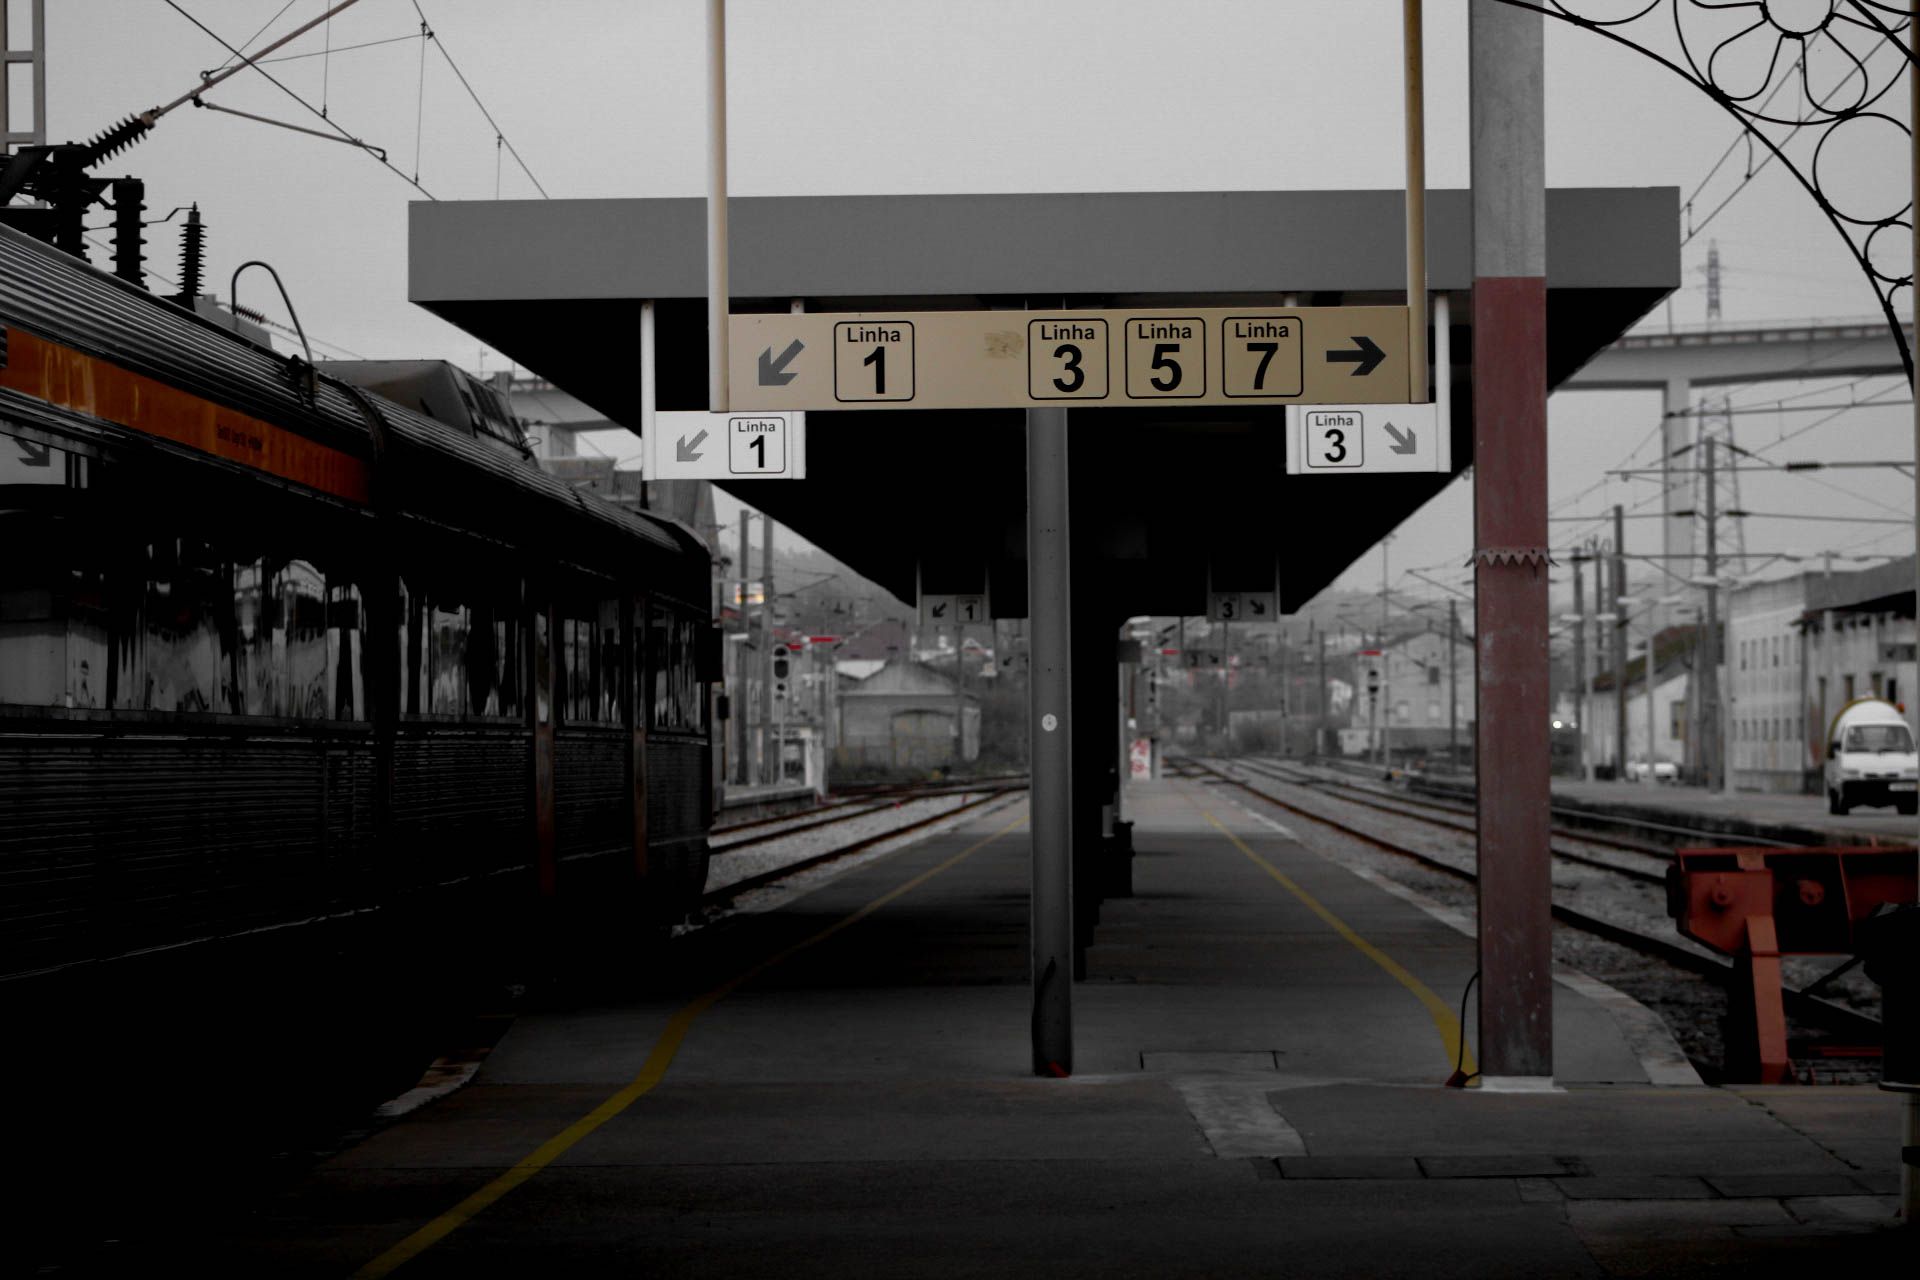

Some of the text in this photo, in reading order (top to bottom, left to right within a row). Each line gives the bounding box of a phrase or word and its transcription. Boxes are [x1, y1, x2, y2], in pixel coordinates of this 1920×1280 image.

[847, 326, 901, 343] Linha
[1041, 324, 1095, 340] Linha
[1138, 323, 1192, 339] Linha
[1235, 321, 1289, 338] Linha
[863, 345, 886, 395] 1
[1052, 343, 1085, 393] 3
[1150, 343, 1183, 392] 5
[1246, 342, 1279, 390] 7
[738, 421, 776, 432] Linha
[1315, 415, 1353, 426] Linha
[749, 434, 765, 469] 1
[1324, 428, 1347, 463] 3
[966, 604, 974, 620] 1
[1222, 602, 1233, 618] 3
